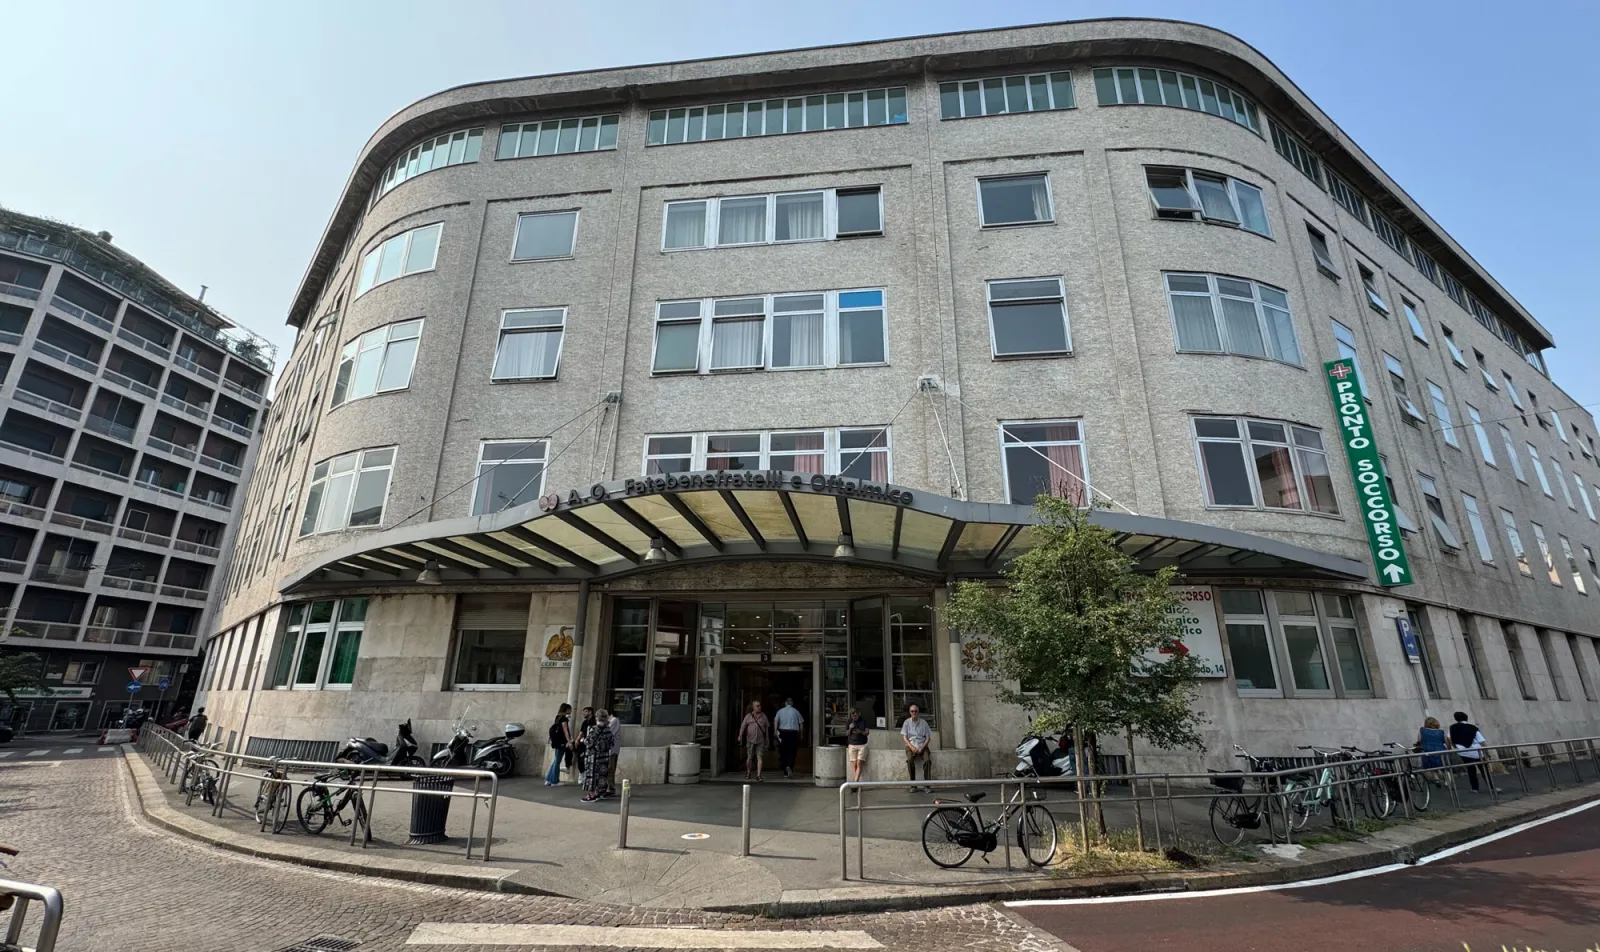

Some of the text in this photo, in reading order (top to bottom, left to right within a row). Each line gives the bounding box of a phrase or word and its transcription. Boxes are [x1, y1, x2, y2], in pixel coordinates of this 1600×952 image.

[1337, 381, 1400, 561] PRONTO SOCCORSO
[624, 469, 783, 495] Fatebenefratelli
[790, 475, 804, 489] e
[810, 473, 914, 505] Oftalmico
[1400, 619, 1410, 637] P
[1215, 664, 1225, 674] 14
